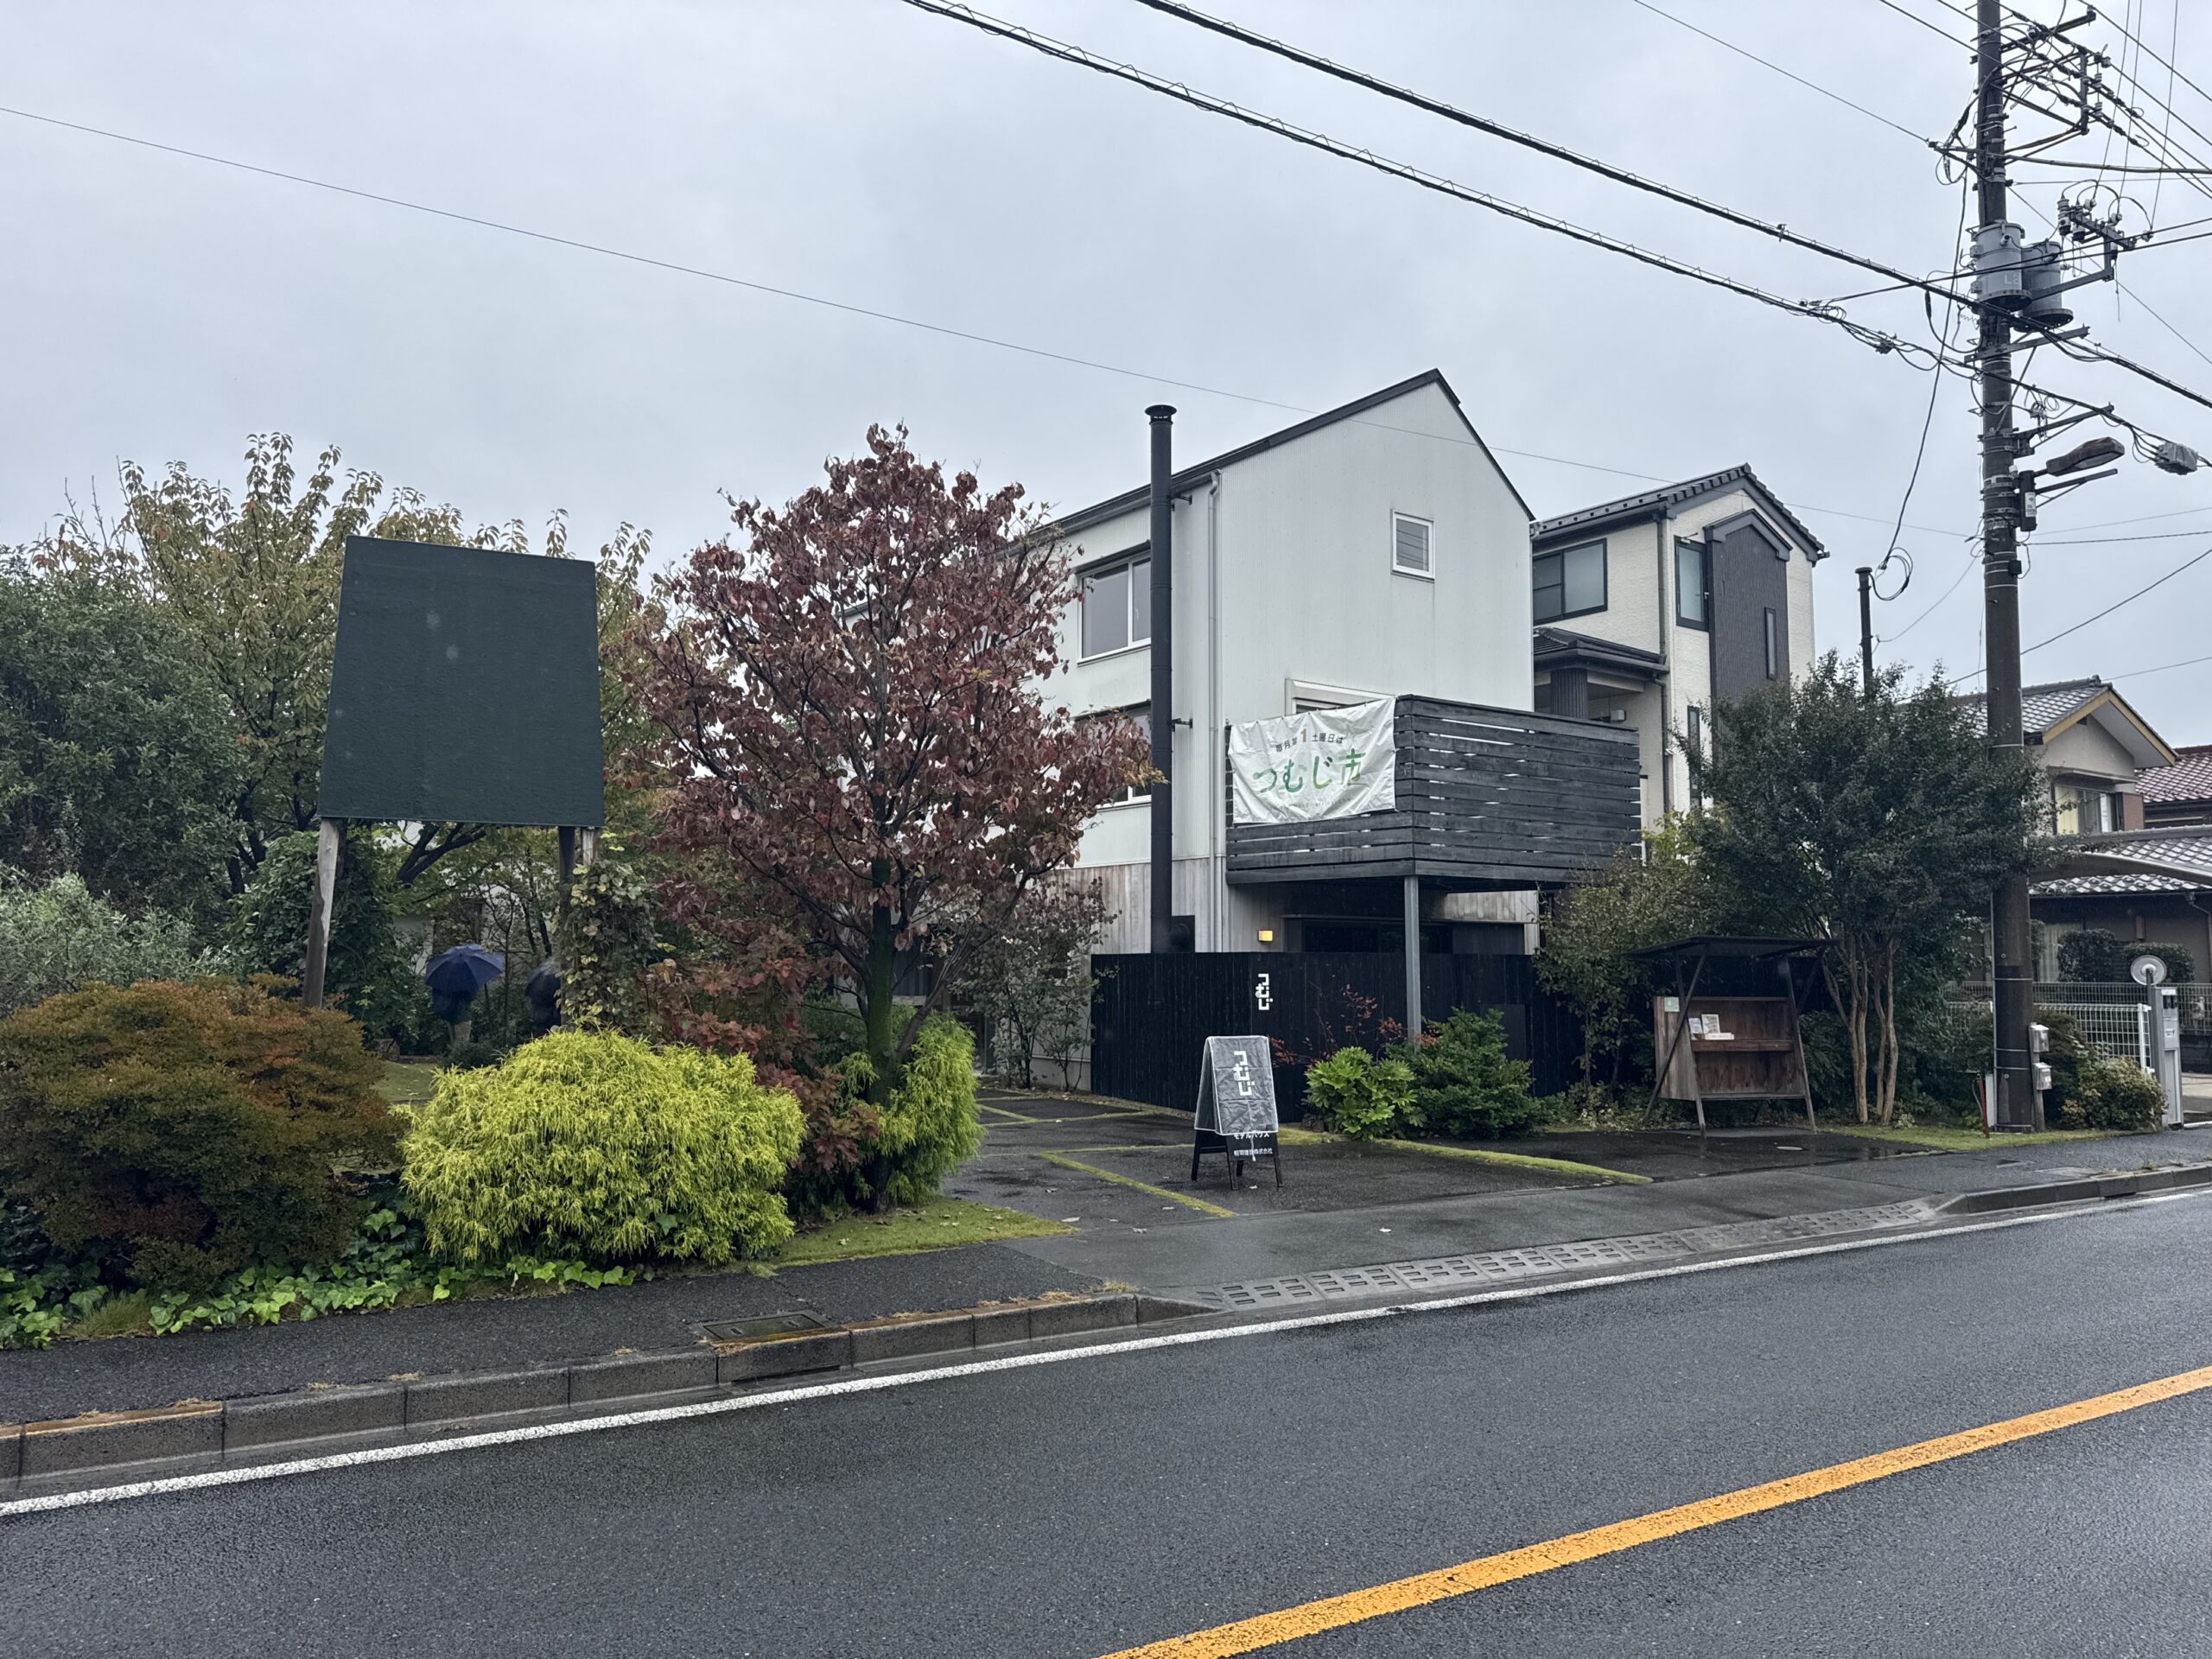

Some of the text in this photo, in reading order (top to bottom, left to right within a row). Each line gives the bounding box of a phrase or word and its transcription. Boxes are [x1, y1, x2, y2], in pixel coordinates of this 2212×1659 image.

[1253, 748, 1365, 792] つむじ市
[1255, 974, 1273, 1010] つむじ
[1233, 1051, 1255, 1096] つむじ
